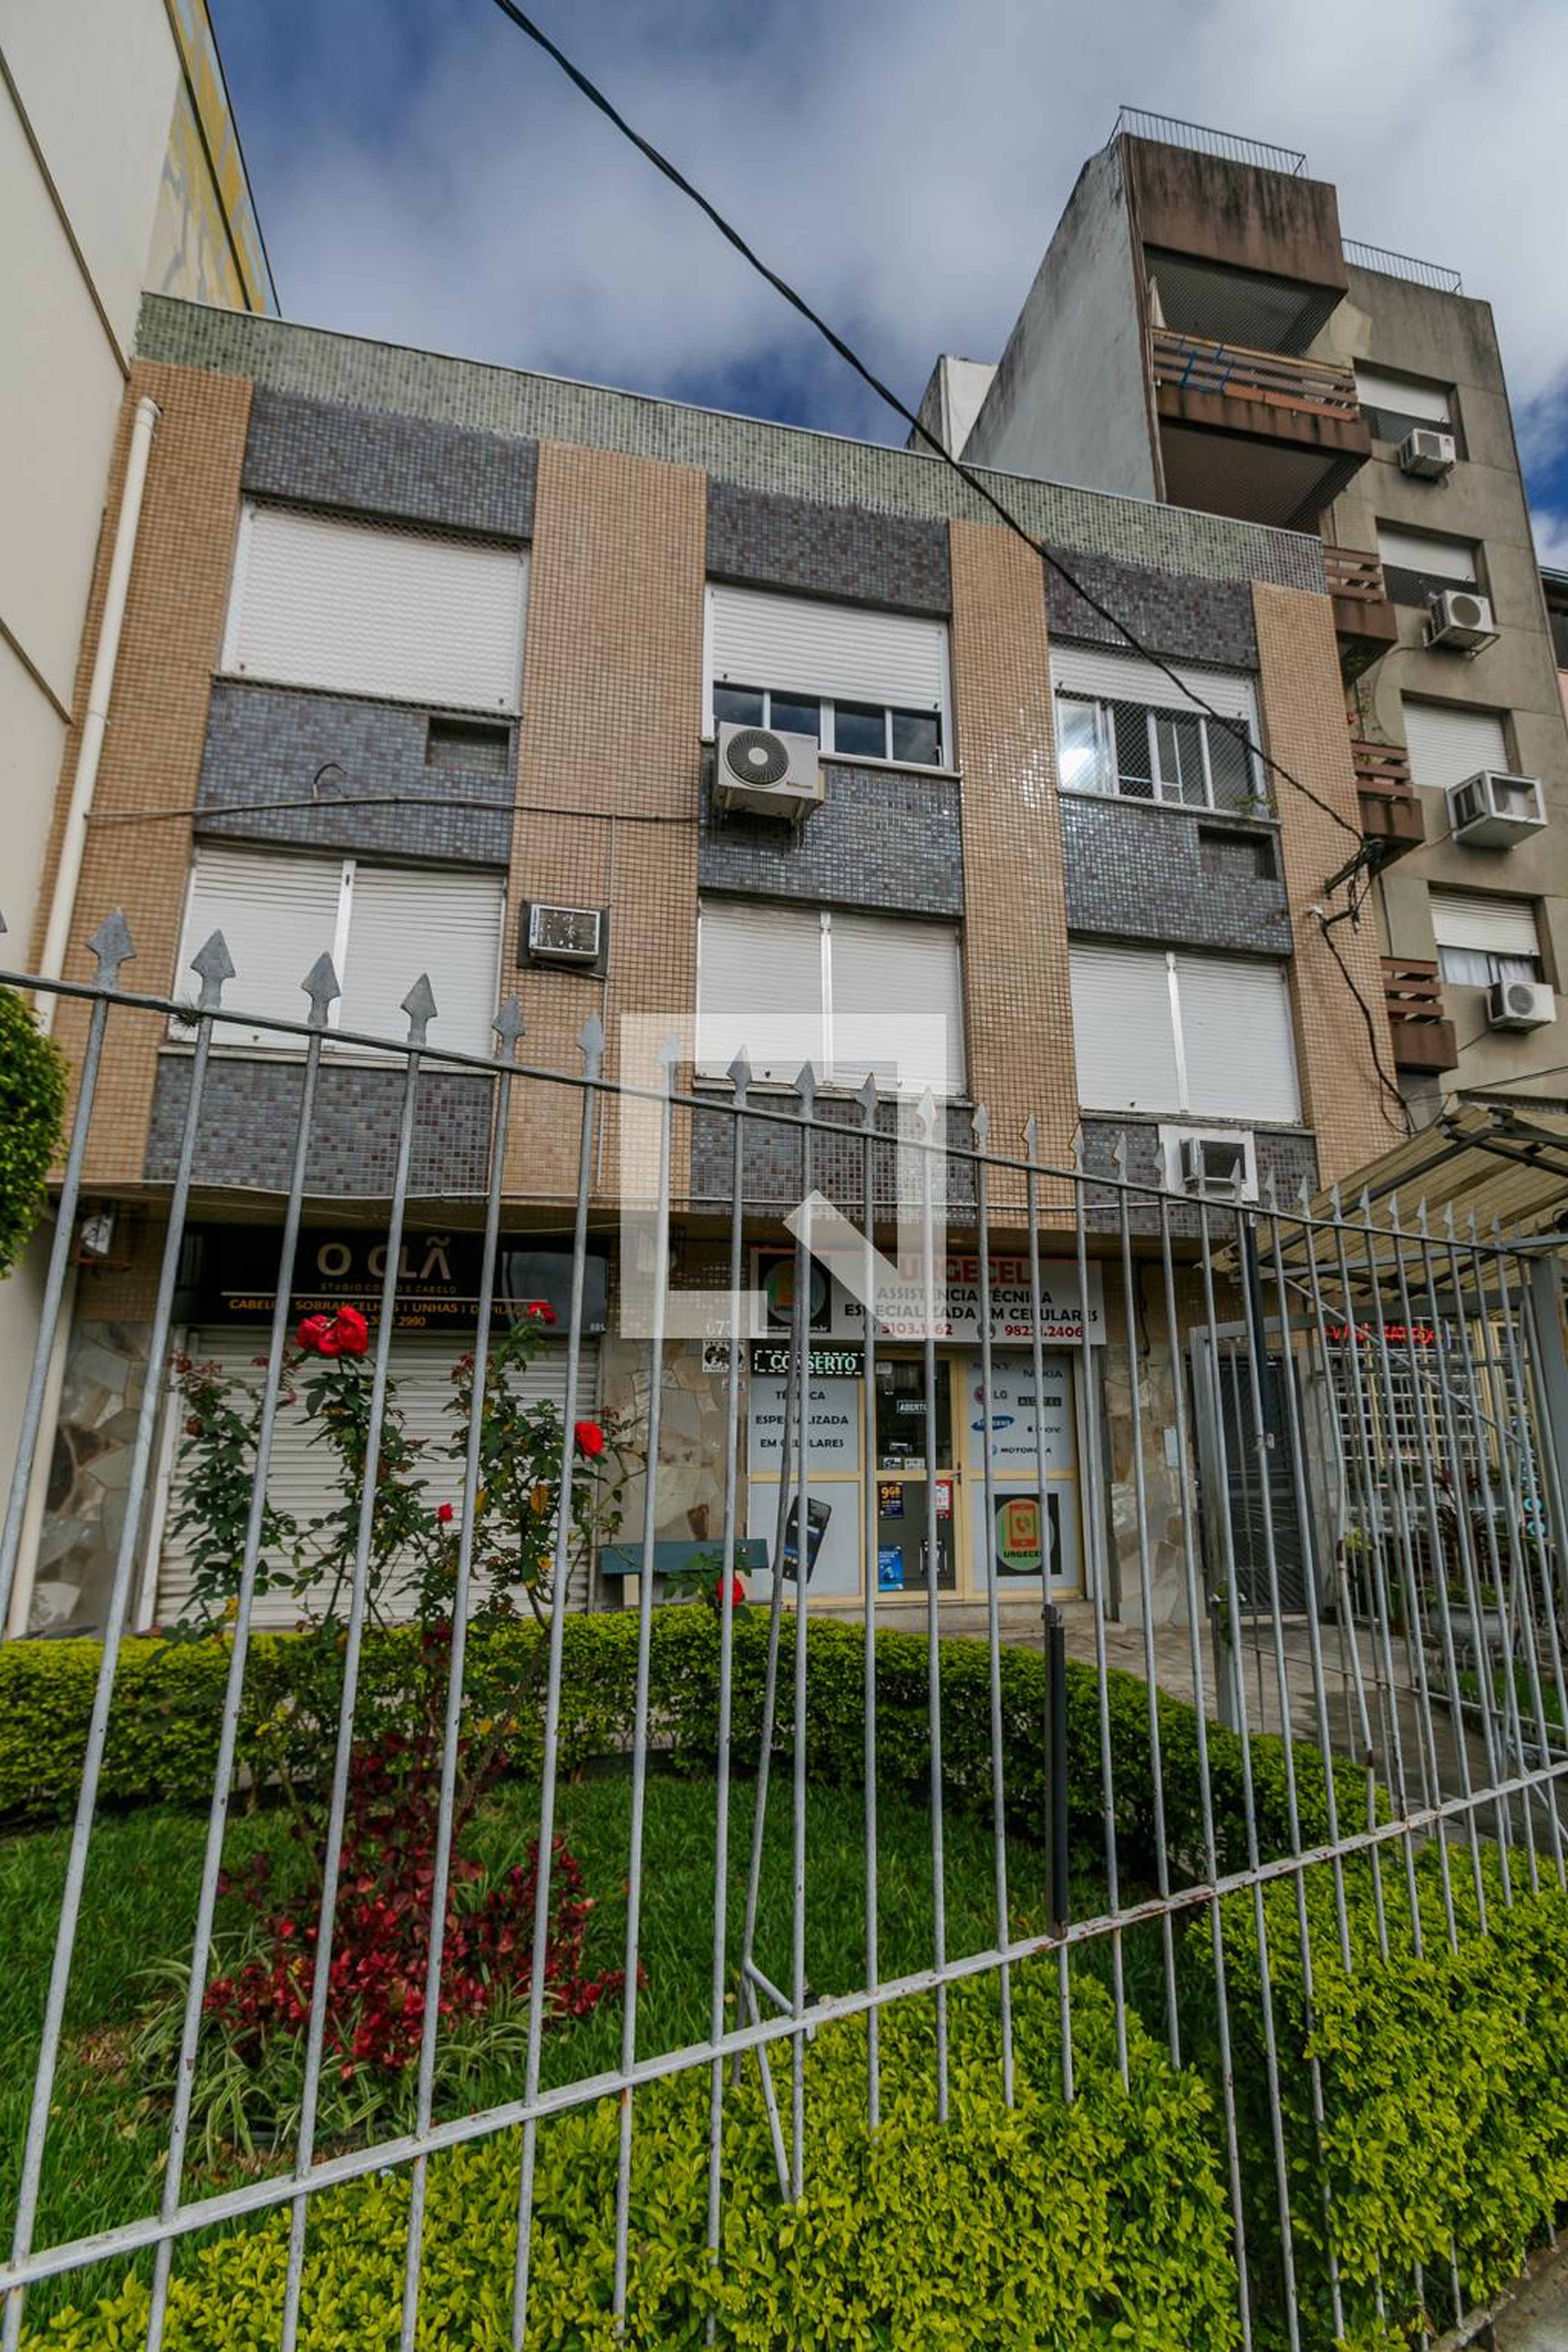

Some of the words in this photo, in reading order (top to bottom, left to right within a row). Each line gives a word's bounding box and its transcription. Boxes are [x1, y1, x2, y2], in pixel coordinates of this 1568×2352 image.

[317, 1243, 352, 1276] O
[878, 1287, 978, 1302] ASSISTNCIA
[988, 1287, 1053, 1303] ÉCNIA
[229, 1299, 276, 1310] CABEL
[771, 1354, 856, 1371] COSERTO
[993, 1390, 1008, 1399] LG
[760, 1439, 777, 1448] EM
